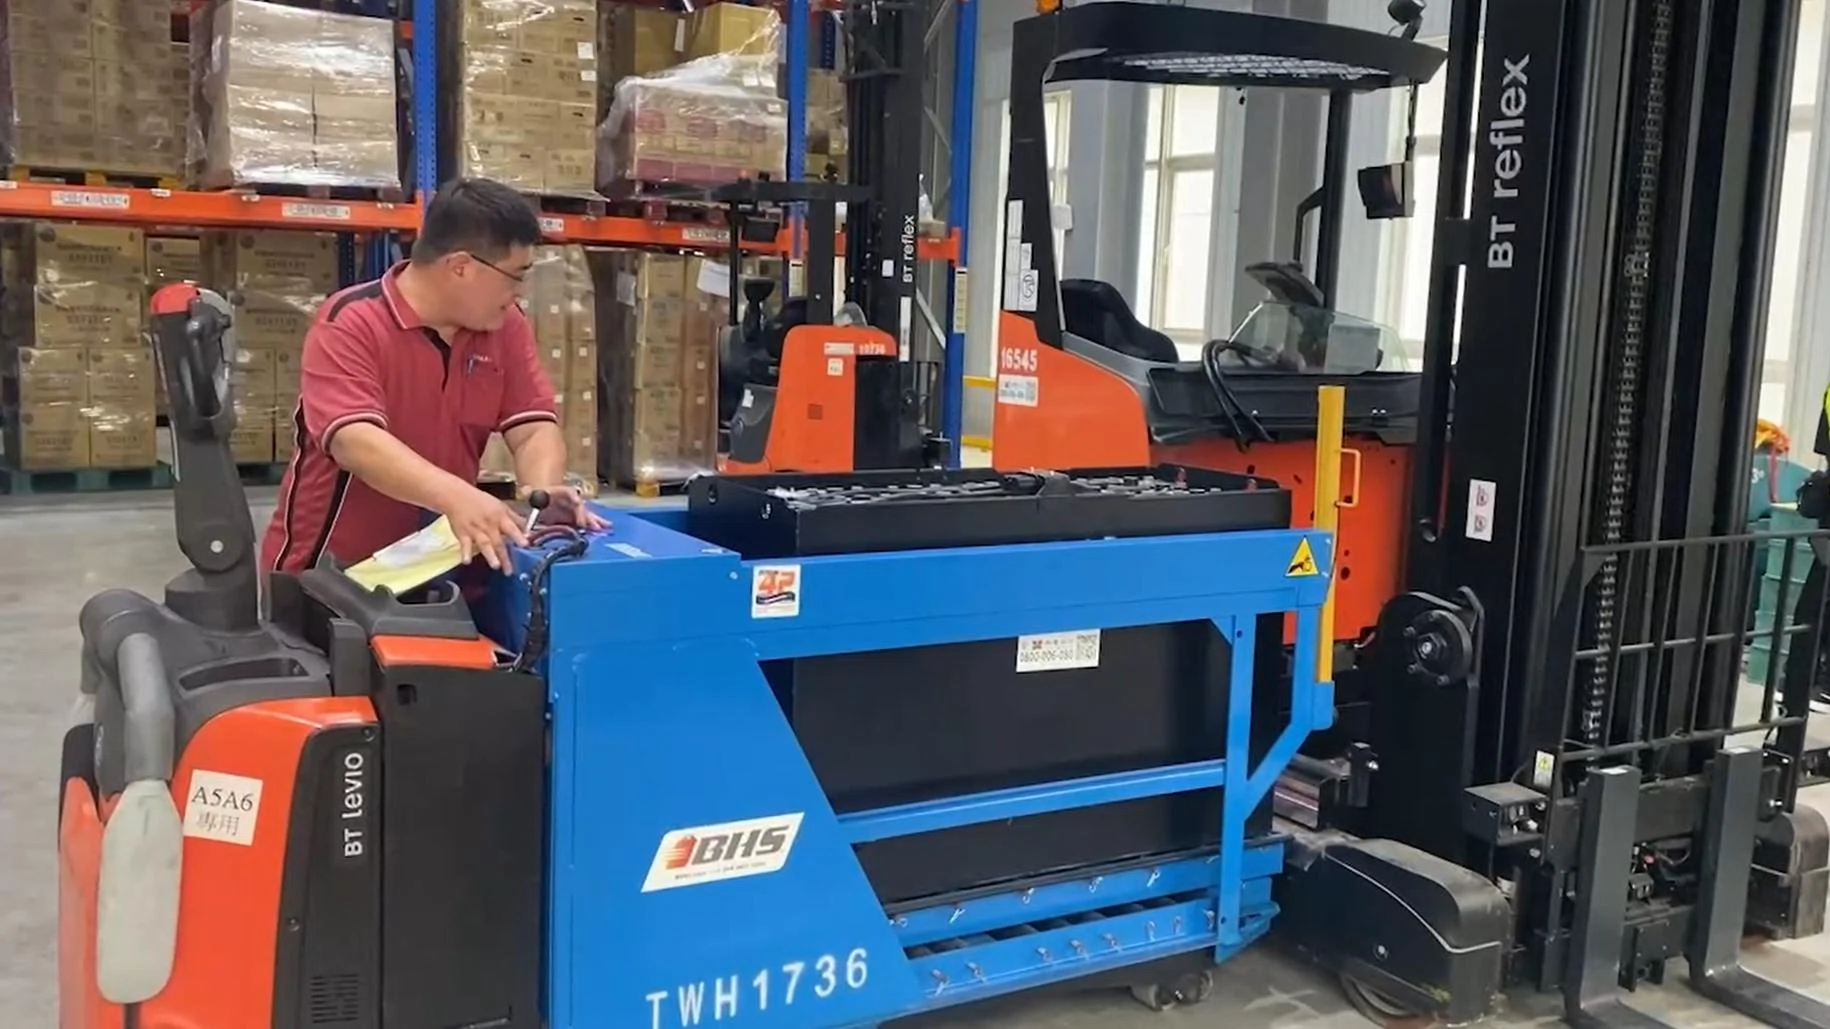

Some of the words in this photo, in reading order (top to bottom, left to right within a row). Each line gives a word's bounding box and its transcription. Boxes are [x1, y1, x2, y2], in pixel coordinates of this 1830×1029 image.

[1489, 53, 1531, 198] reflex
[901, 214, 915, 261] reflex
[1487, 215, 1517, 269] BT
[902, 264, 914, 283] BT
[1001, 347, 1038, 372] 16545
[191, 785, 255, 812] A5A6
[343, 828, 364, 857] BT
[691, 825, 790, 866] BHS
[645, 948, 868, 1029] TWH1736
